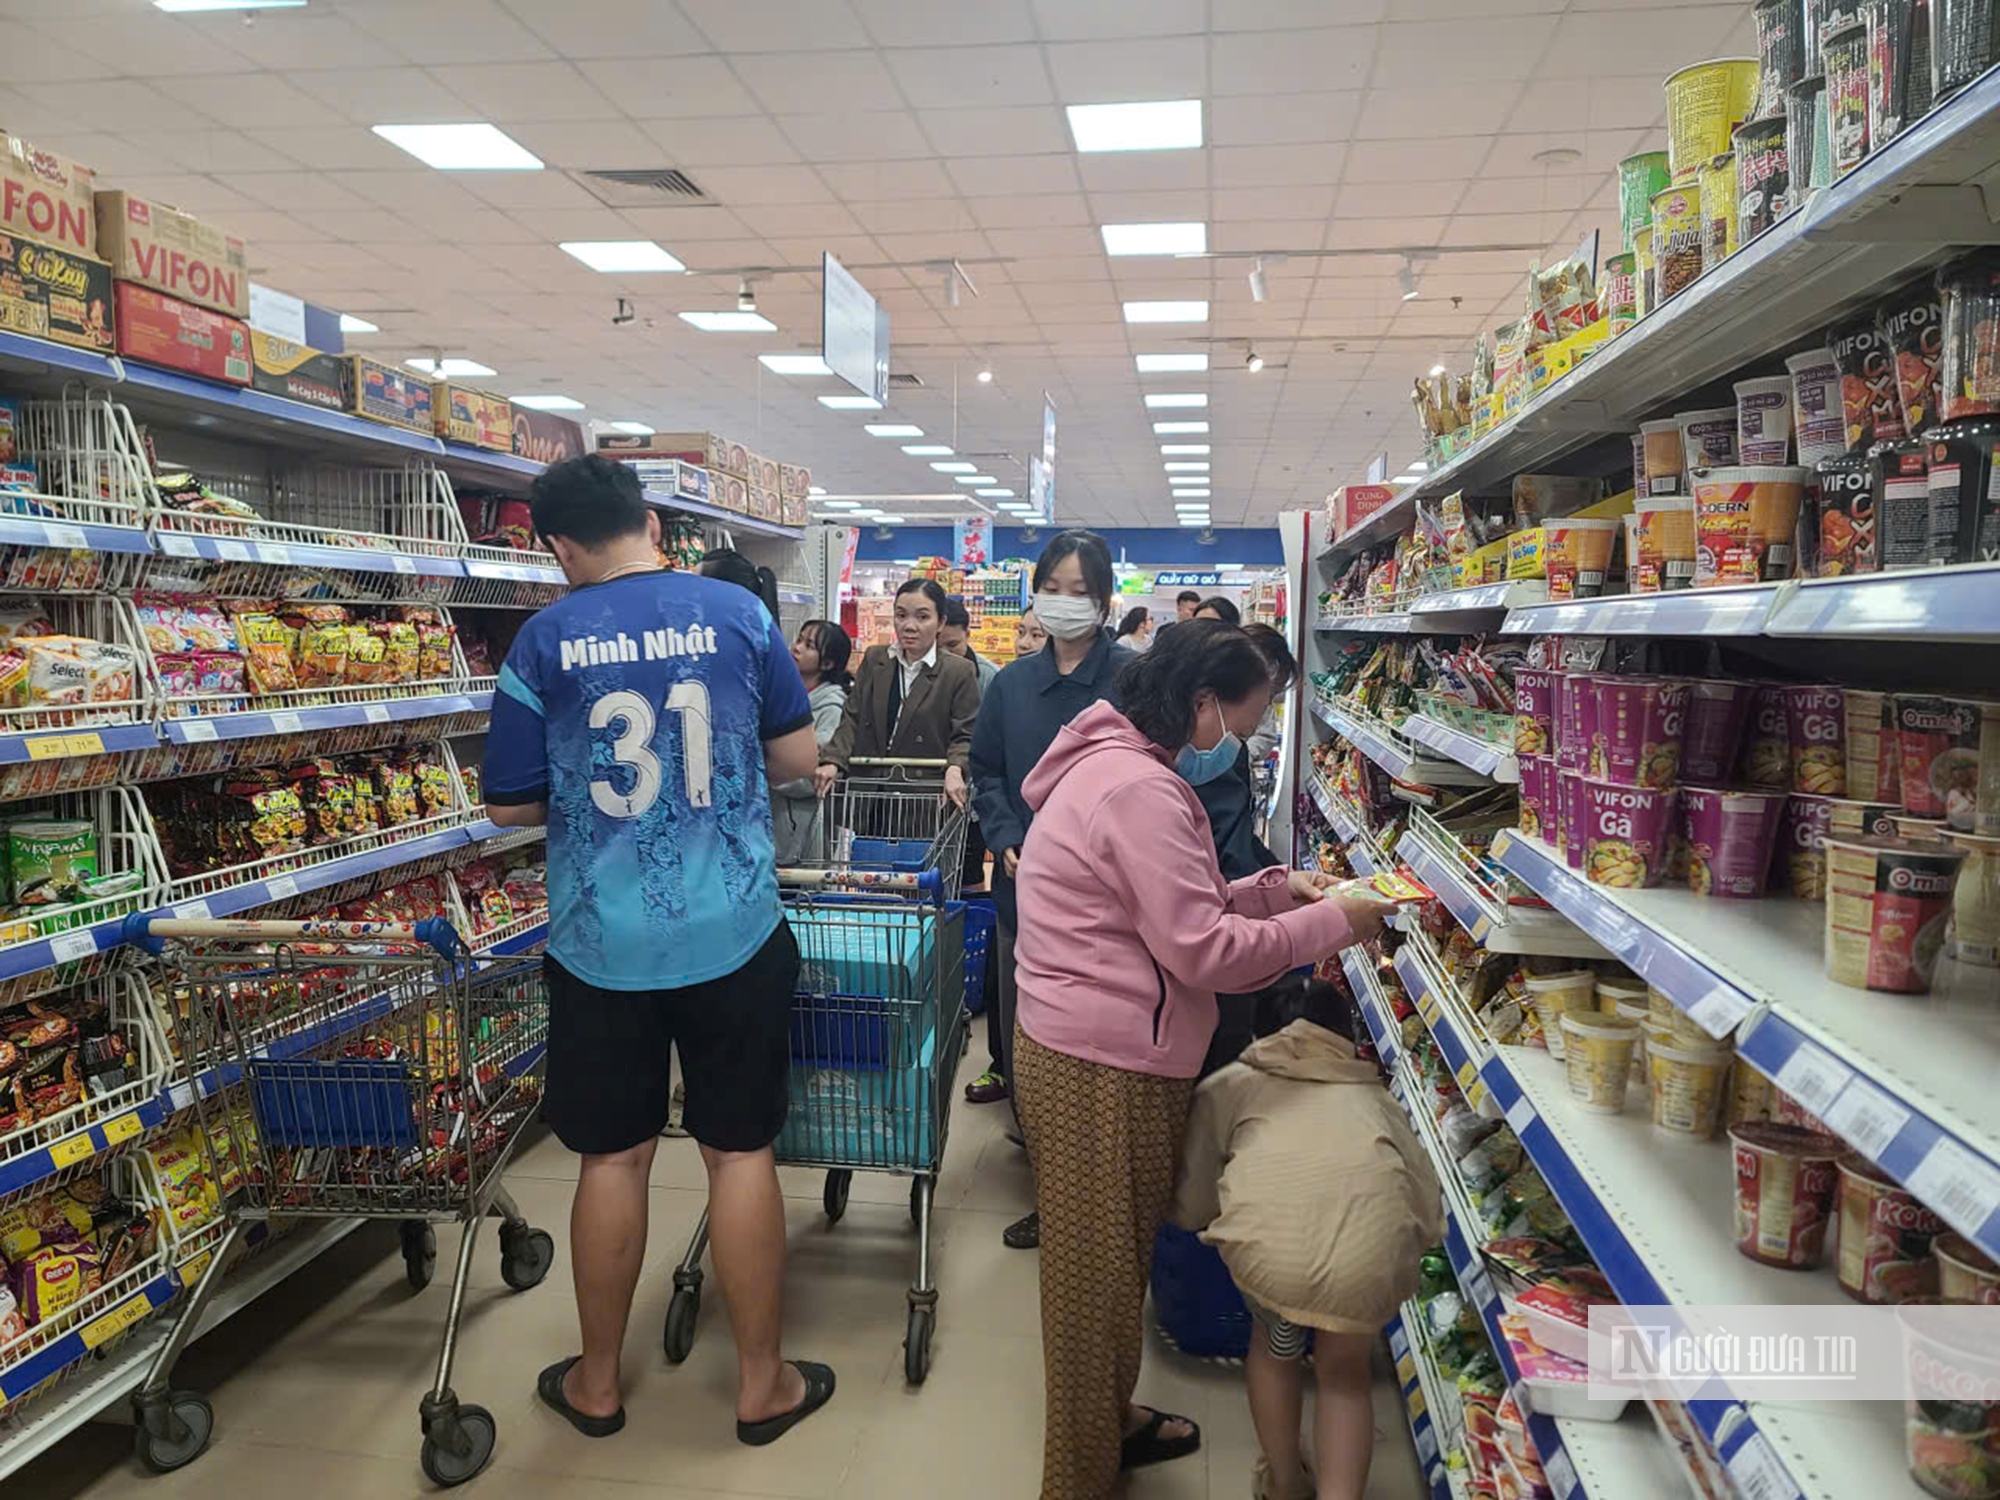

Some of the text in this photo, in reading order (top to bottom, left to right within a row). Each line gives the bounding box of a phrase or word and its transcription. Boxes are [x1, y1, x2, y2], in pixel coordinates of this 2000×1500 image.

[131, 237, 237, 307] VIFON
[560, 623, 718, 671] Minh Nhật
[50, 662, 85, 680] Select
[1803, 714, 1839, 741] Gà
[588, 679, 713, 820] 31
[1594, 789, 1652, 809] VIFON
[1599, 810, 1632, 839] Gà
